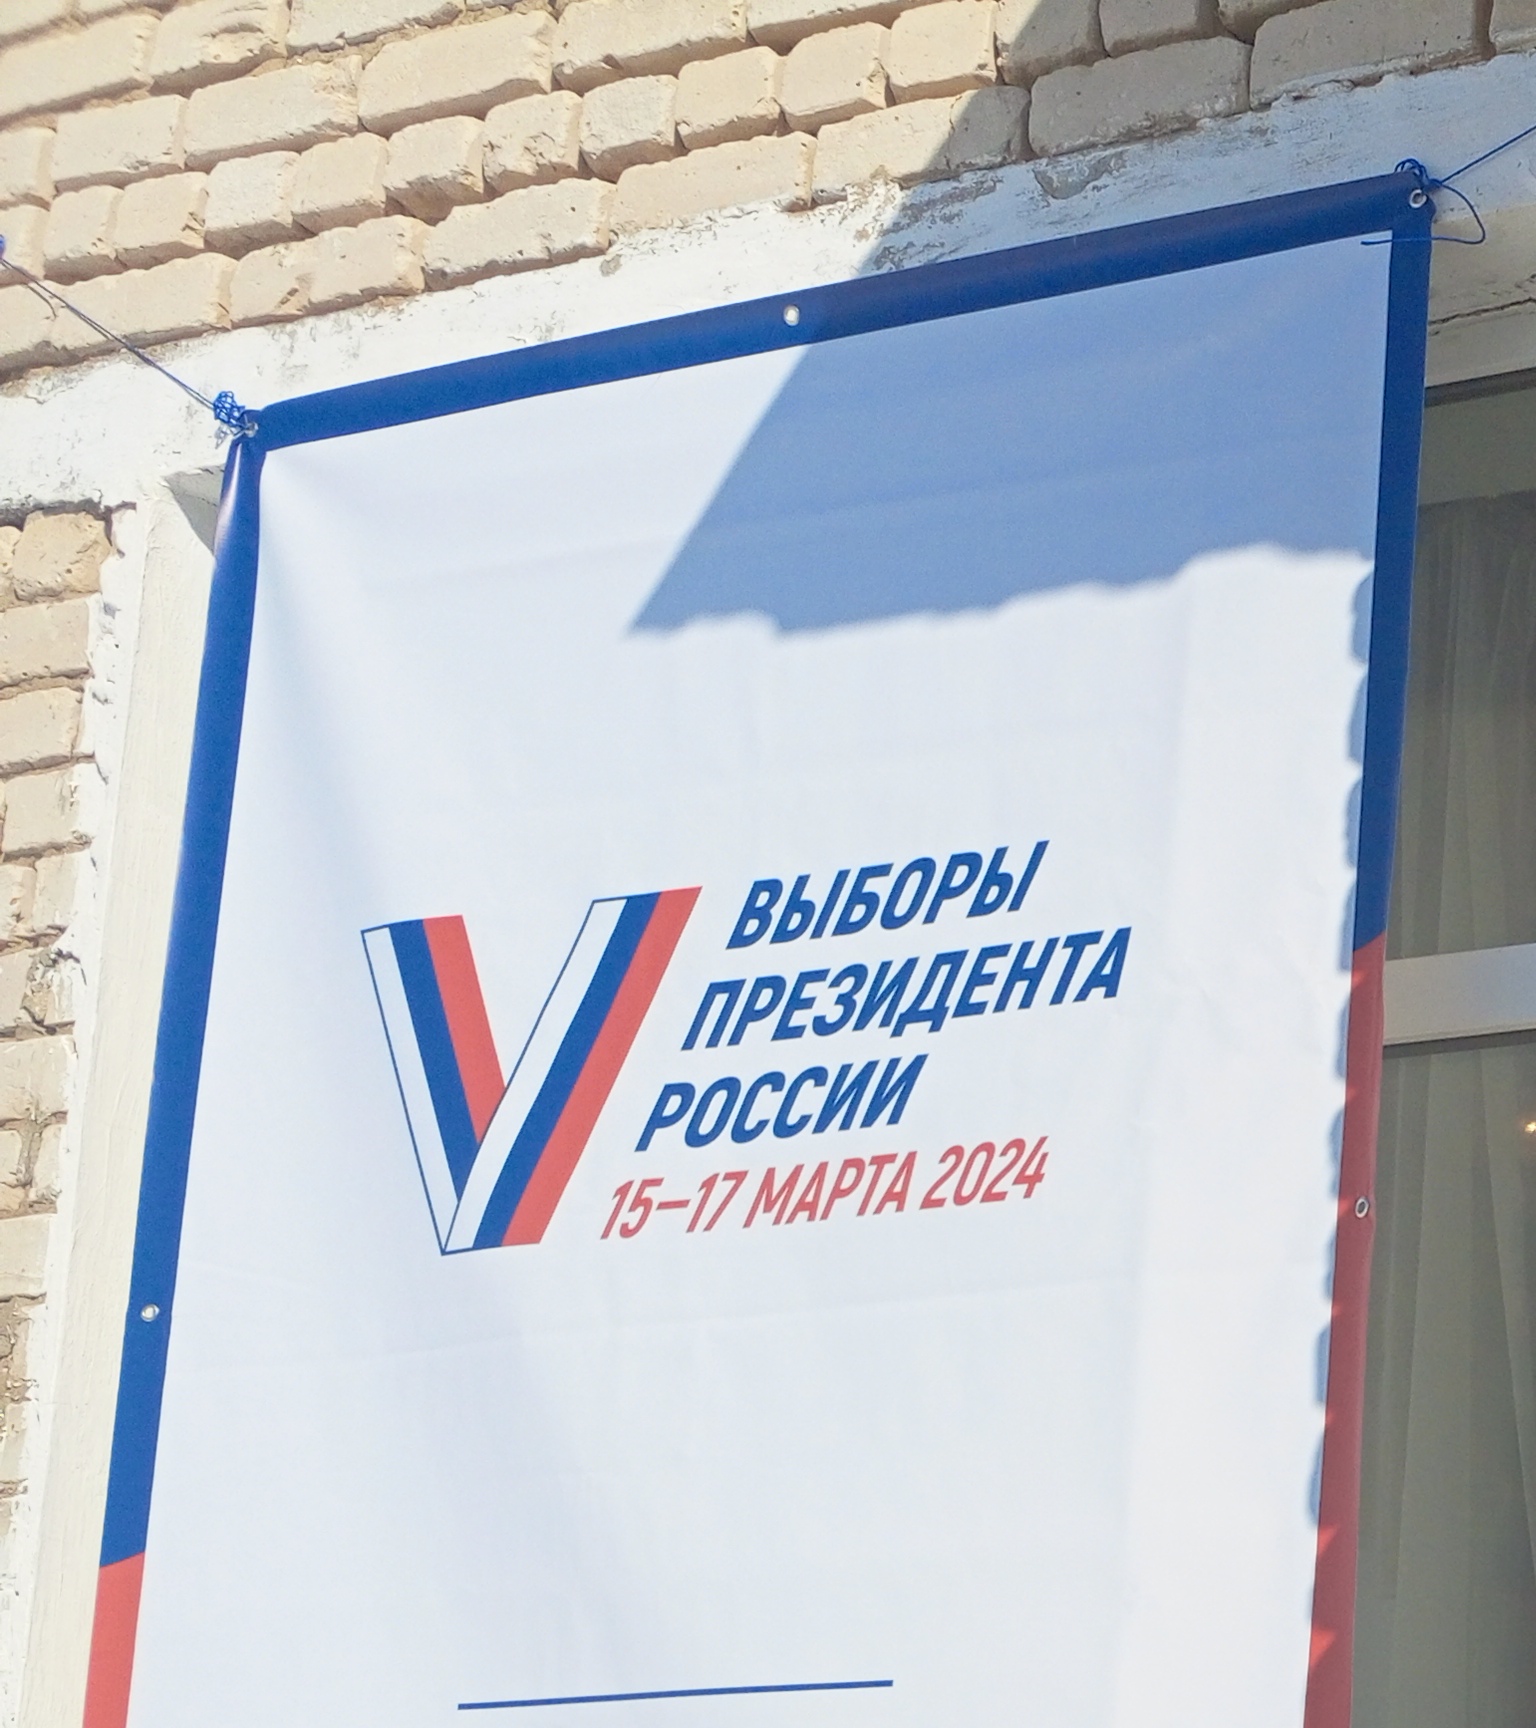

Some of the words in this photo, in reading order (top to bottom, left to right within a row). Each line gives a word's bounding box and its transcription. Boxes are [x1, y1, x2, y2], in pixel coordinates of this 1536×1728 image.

[725, 840, 1050, 950] ВЫБОРЫ
[680, 926, 1133, 1052] ПРЕЗИДЕНТА
[634, 1053, 930, 1153] РОССИИ
[741, 1149, 919, 1228] МАРТА
[919, 1135, 1051, 1210] 2024
